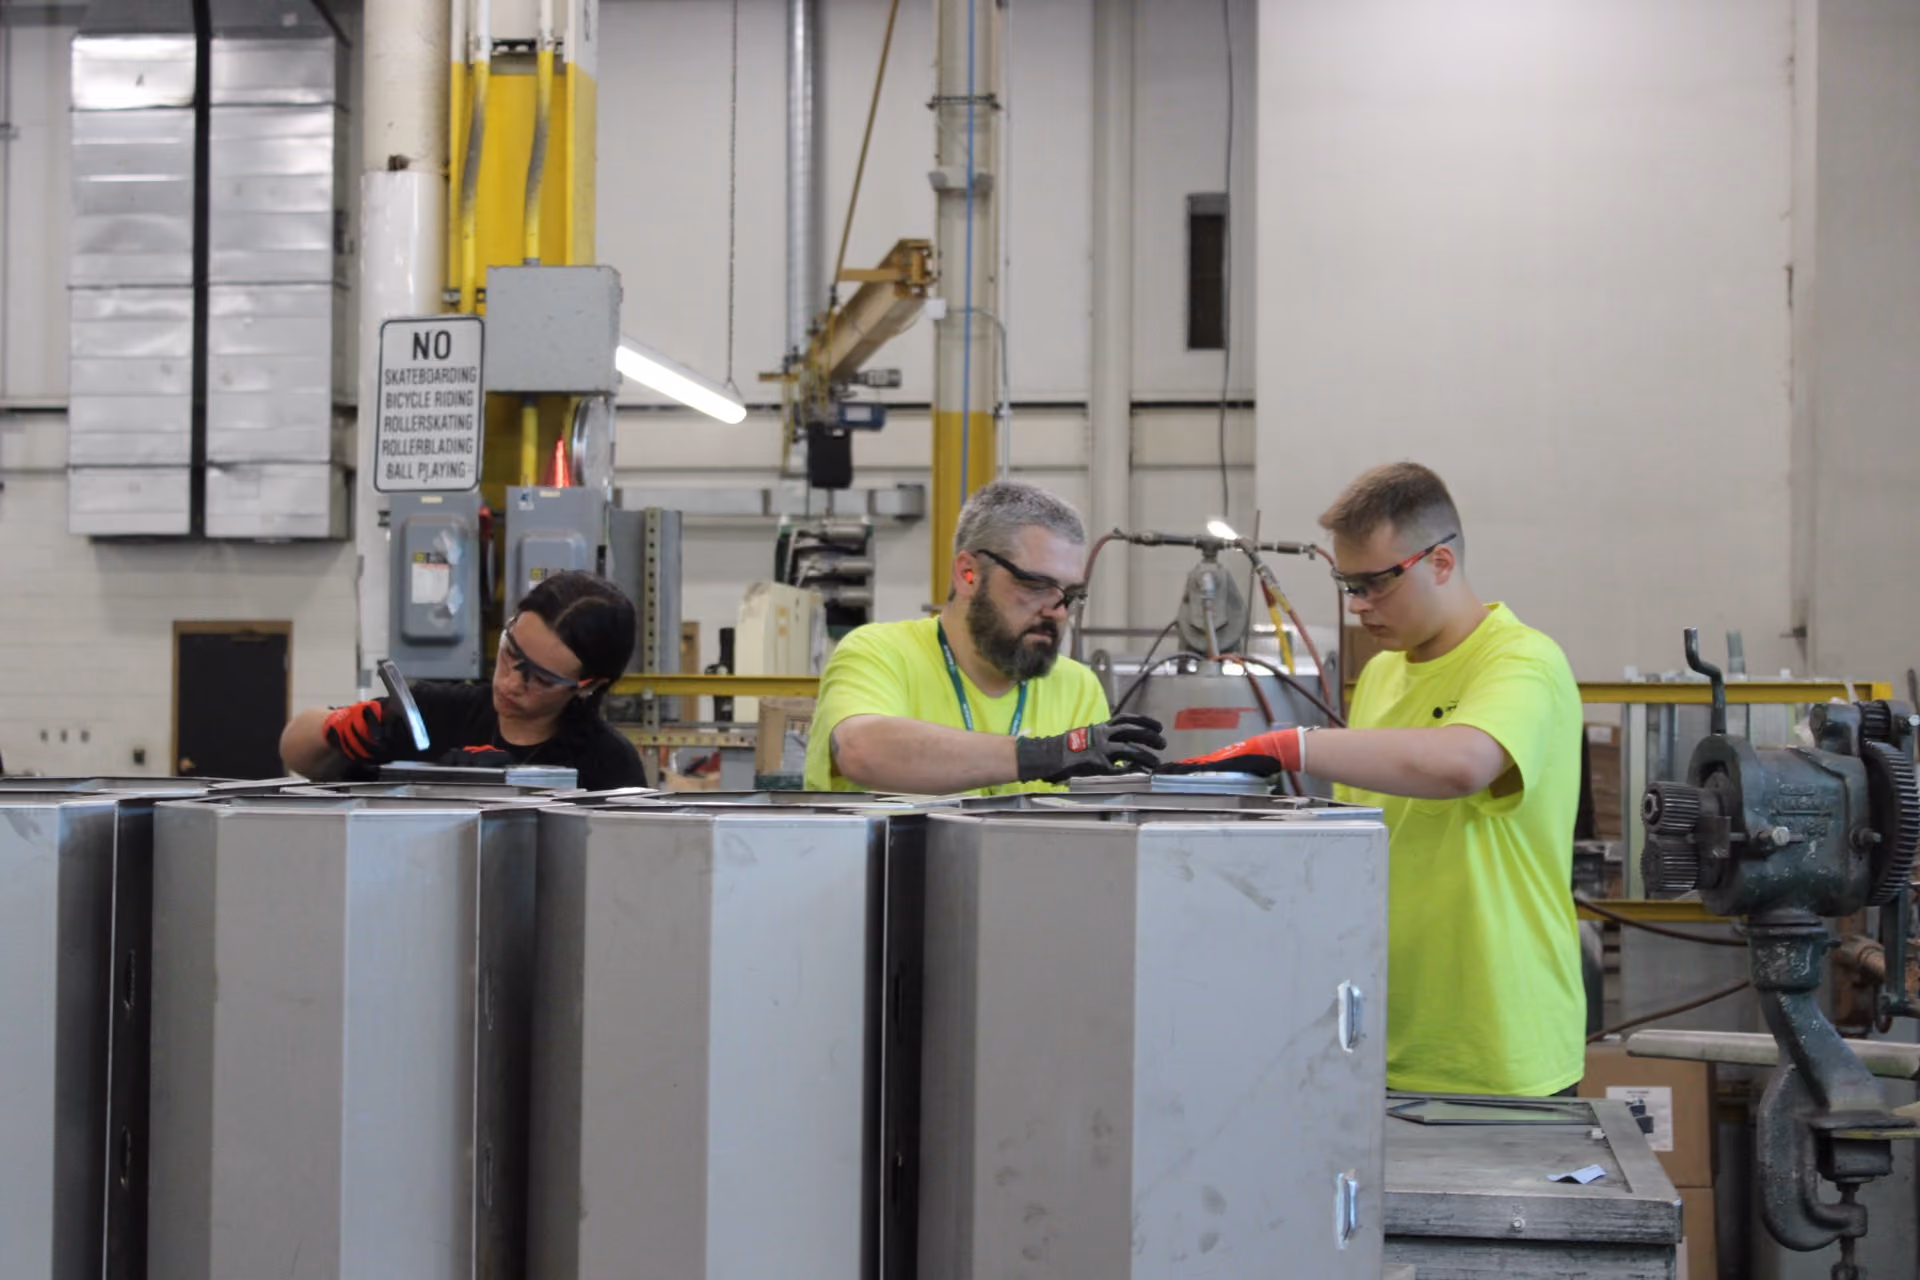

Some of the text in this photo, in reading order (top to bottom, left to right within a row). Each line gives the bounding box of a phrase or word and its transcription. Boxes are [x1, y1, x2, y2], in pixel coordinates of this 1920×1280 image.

[413, 330, 451, 360] NO
[385, 367, 477, 386] SKATEBOARDING
[386, 389, 474, 409] BICYCLE RIDING
[383, 414, 473, 433] ROLLERSKATING
[382, 437, 473, 456] ROLLERBLADING
[386, 461, 466, 480] BALL PLAYING
